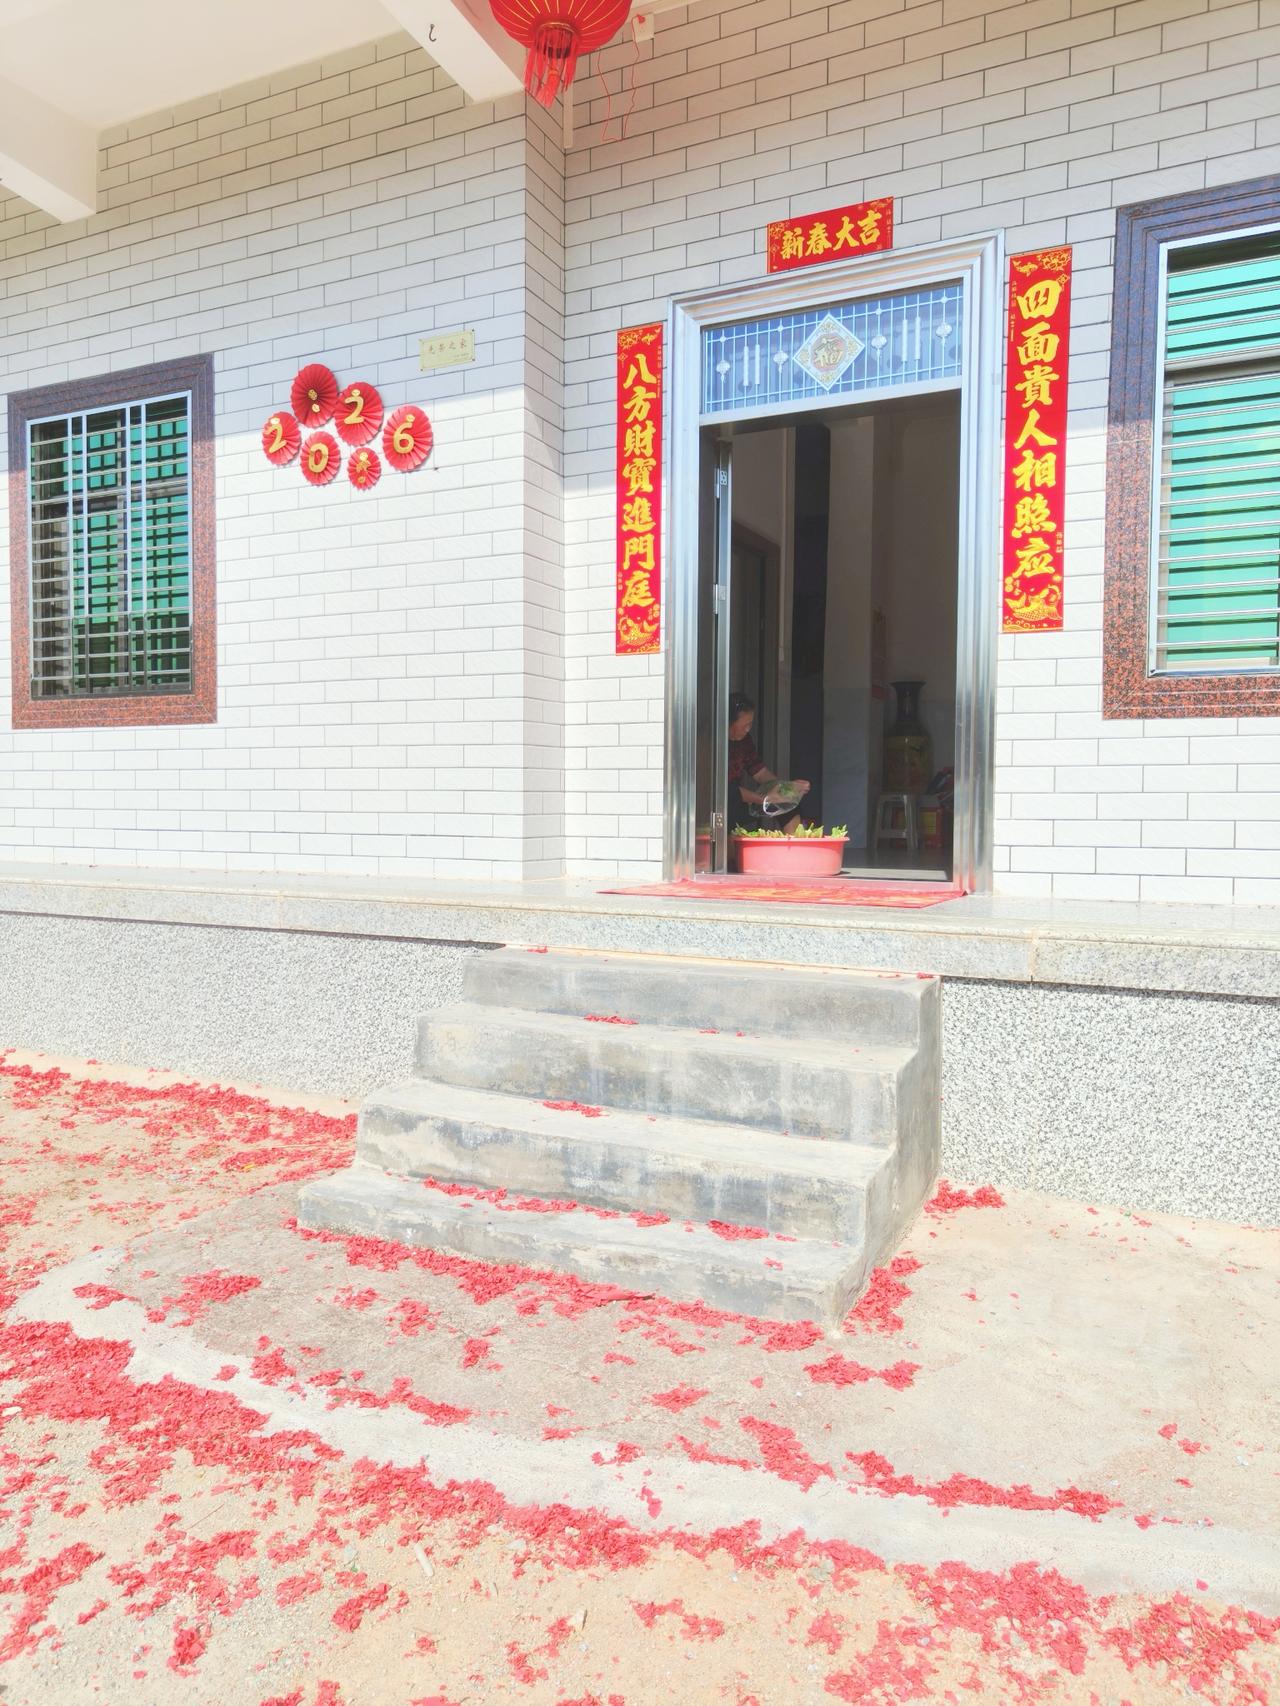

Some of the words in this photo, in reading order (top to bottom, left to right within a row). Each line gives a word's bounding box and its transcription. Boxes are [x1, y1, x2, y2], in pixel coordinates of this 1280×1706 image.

[780, 209, 882, 260] 新春大吉
[621, 353, 657, 608] 八方財寶進門庭
